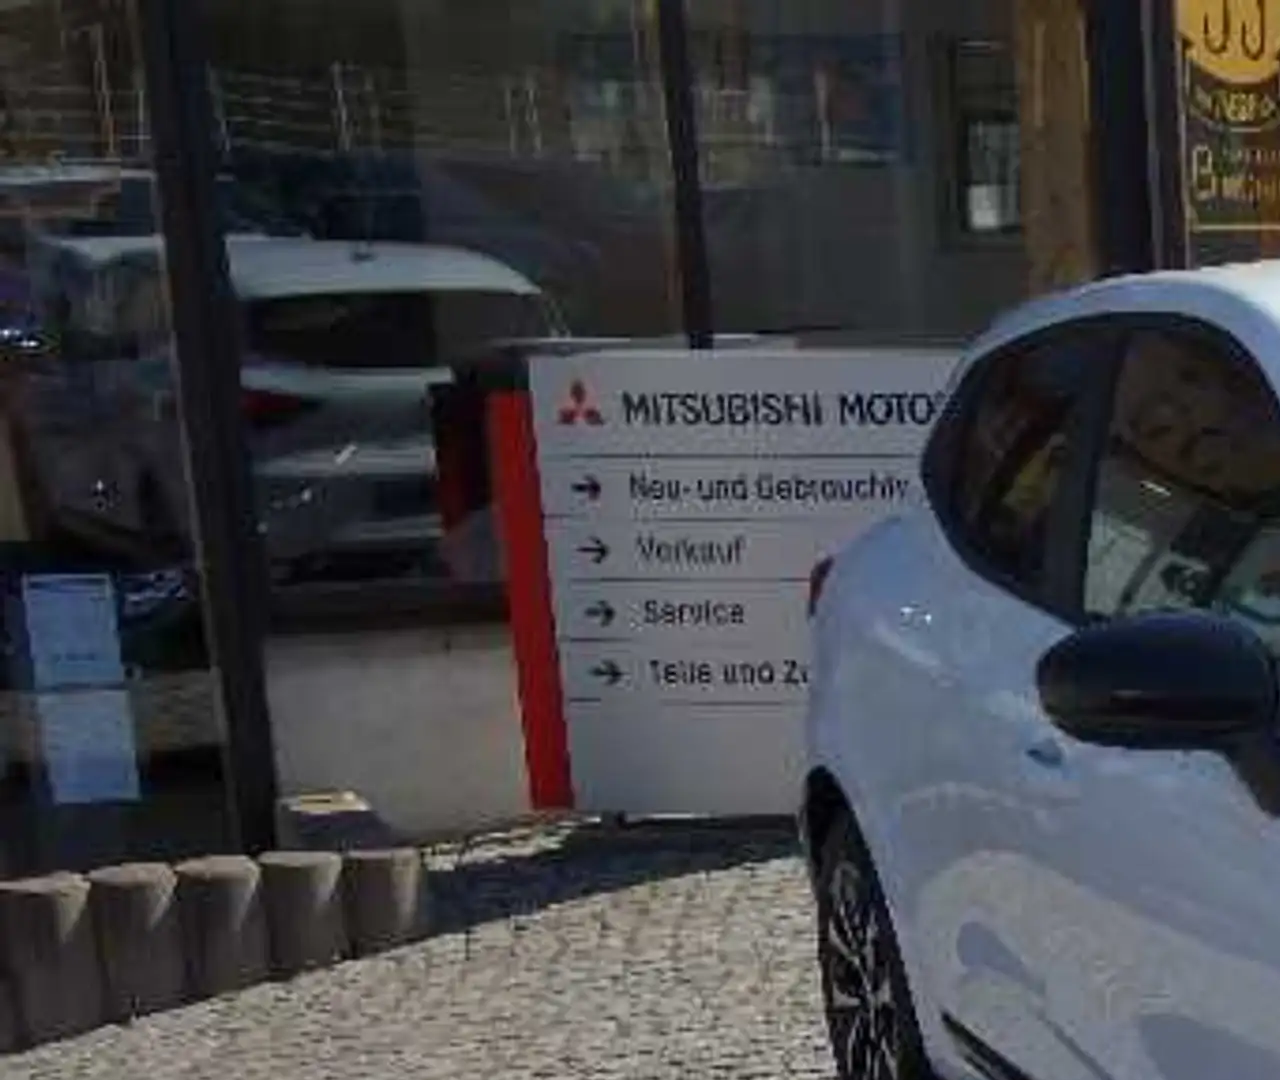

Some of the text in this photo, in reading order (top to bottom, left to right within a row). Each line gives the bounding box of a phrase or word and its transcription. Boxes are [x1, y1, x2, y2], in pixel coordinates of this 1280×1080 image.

[621, 391, 947, 427] MITSUBISHI MOTO
[628, 473, 690, 501] Neu-
[696, 473, 749, 501] und
[635, 536, 747, 565] Verkauf
[643, 600, 745, 625] Service
[649, 658, 713, 685] Teile
[723, 659, 775, 685] und
